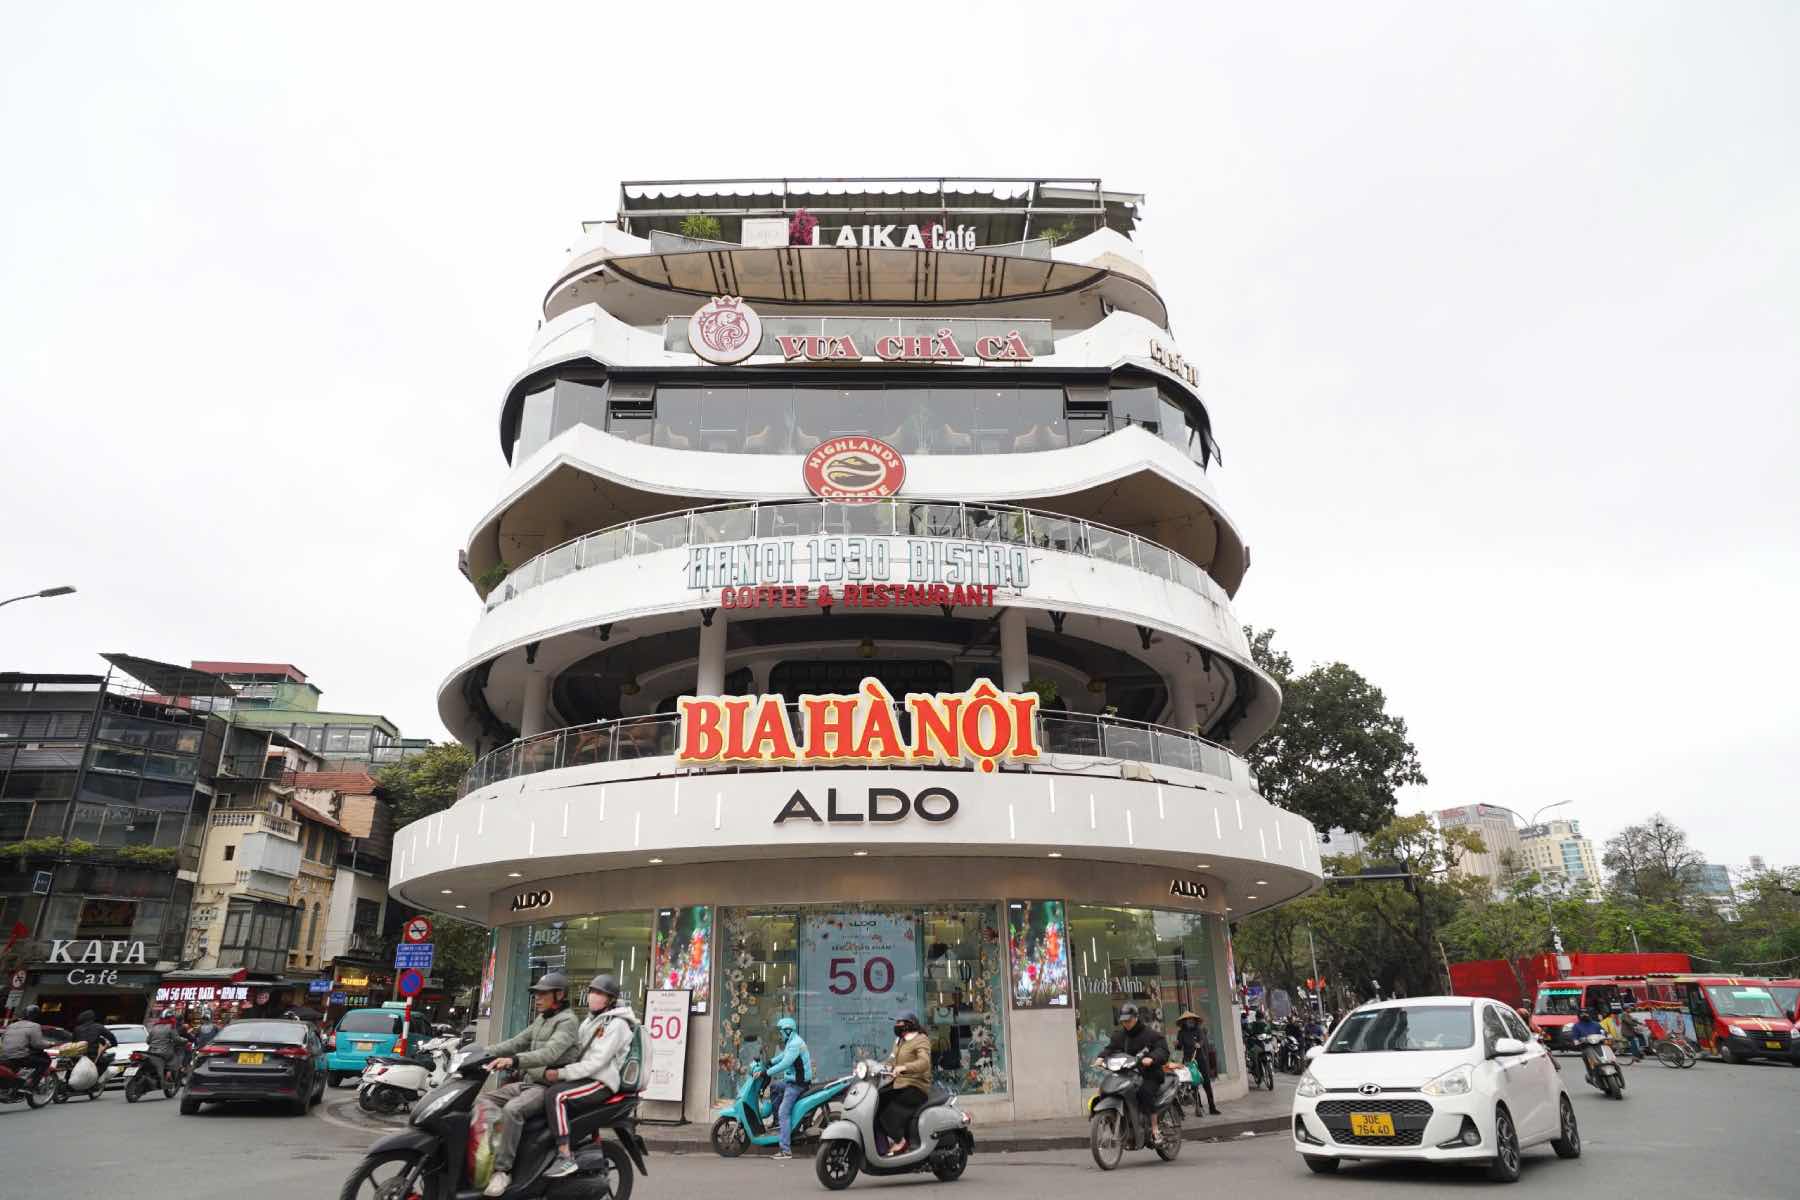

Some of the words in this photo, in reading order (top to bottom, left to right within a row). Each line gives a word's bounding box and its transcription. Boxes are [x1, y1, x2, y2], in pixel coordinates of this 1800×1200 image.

[931, 224, 976, 251] Café
[776, 334, 863, 361] VUA
[875, 328, 964, 362] CHẢ
[975, 330, 1034, 362] CÁ
[809, 439, 899, 469] HIGHLANDS
[688, 541, 793, 589] HANOI
[806, 538, 893, 583] 1930
[906, 540, 1031, 588] BISTRO
[721, 586, 810, 610] COFFEE
[817, 585, 833, 608] &
[844, 584, 997, 608] RESTAURANT
[678, 697, 797, 762] BIA
[801, 679, 907, 762] HÀ
[907, 681, 1040, 773] NỘI
[773, 787, 959, 823] ALDO
[511, 889, 553, 912] ALDO
[1169, 880, 1208, 901] ALDO
[45, 939, 146, 964] KAFA
[67, 968, 118, 985] Café
[828, 956, 895, 995] 50
[650, 1015, 682, 1040] 50
